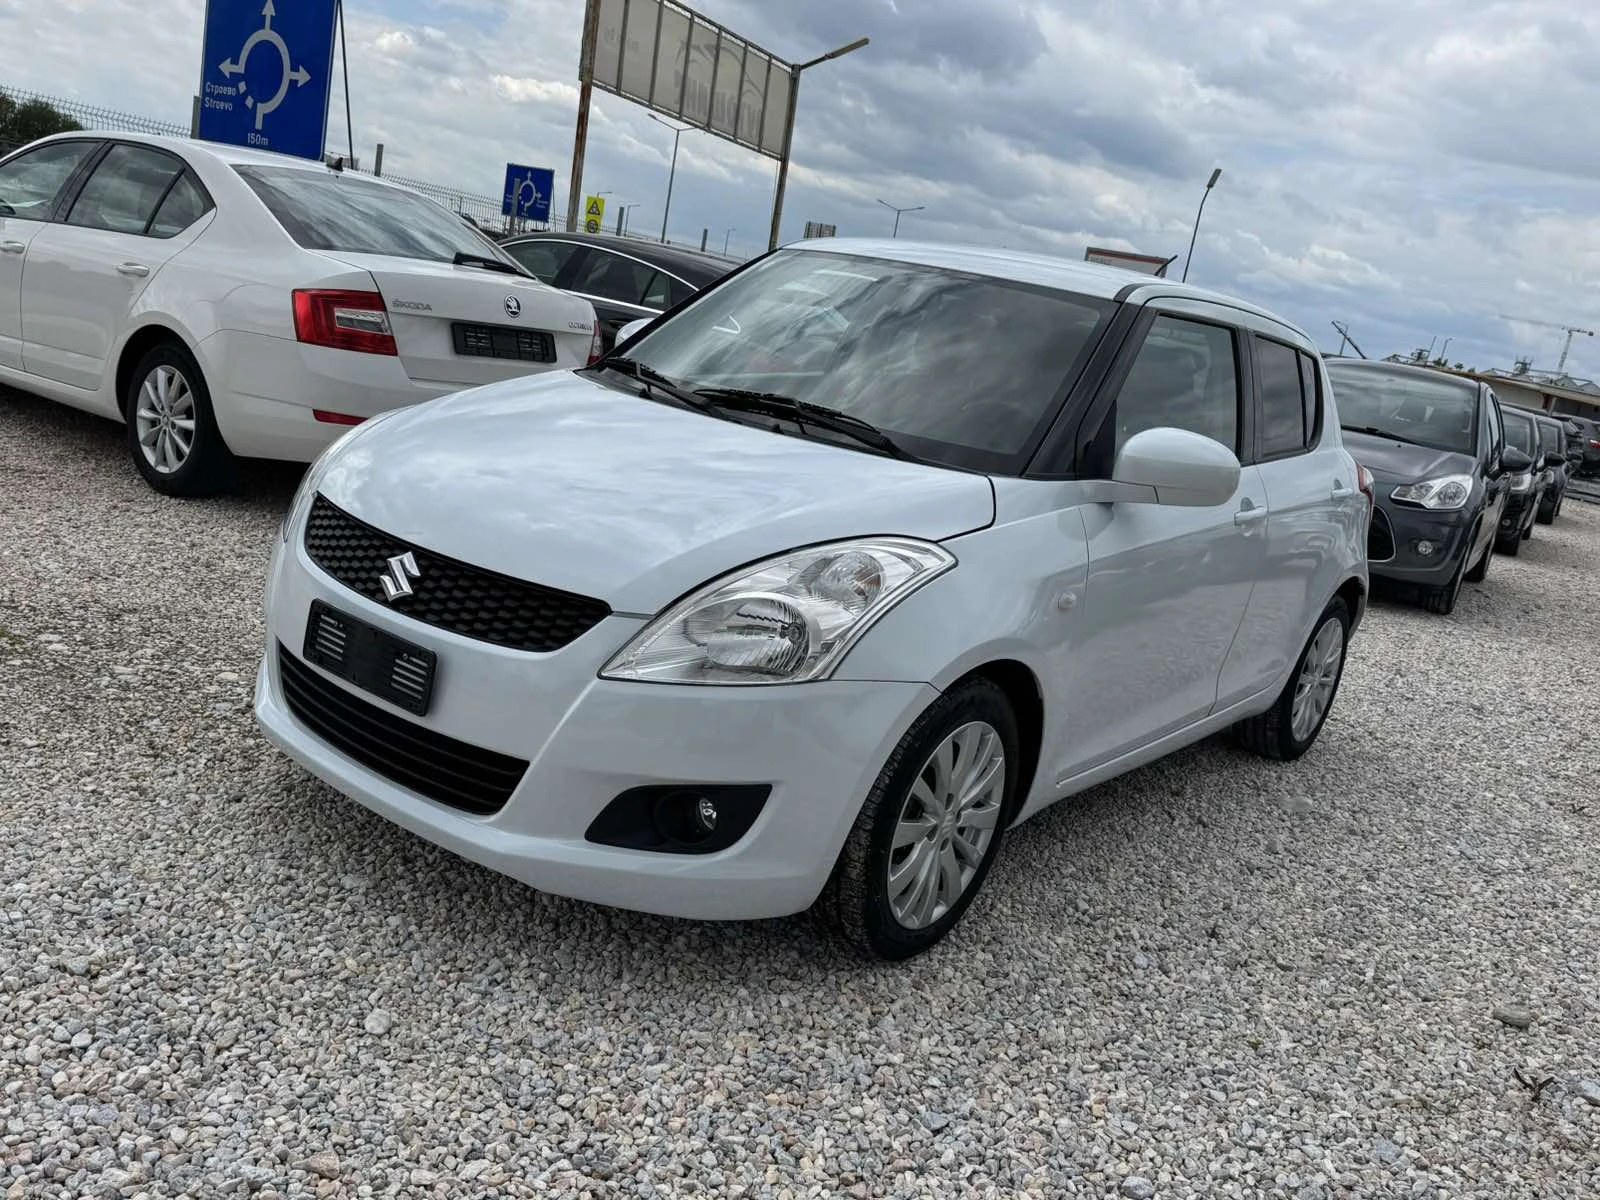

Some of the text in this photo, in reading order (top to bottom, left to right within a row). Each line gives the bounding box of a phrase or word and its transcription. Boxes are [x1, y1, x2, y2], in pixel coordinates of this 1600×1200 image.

[205, 82, 236, 97] Строево
[204, 97, 233, 111] Stroevo
[247, 132, 269, 146] 150m
